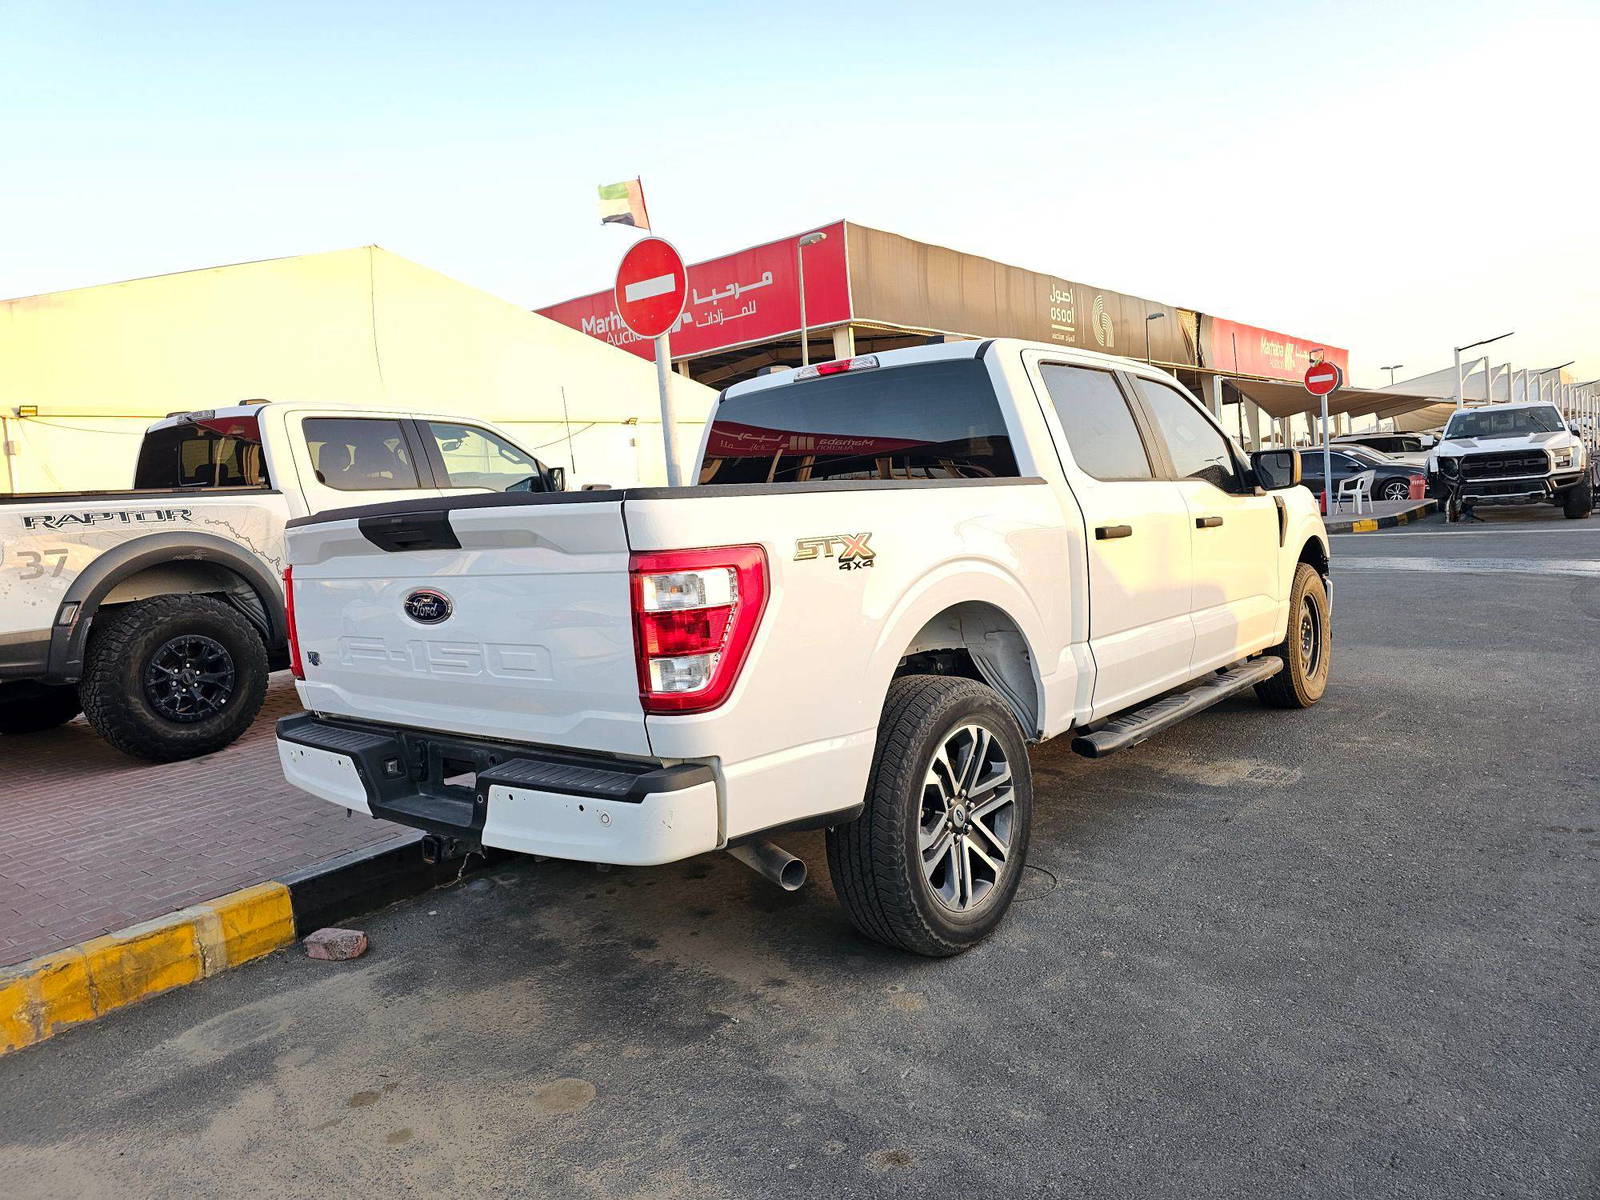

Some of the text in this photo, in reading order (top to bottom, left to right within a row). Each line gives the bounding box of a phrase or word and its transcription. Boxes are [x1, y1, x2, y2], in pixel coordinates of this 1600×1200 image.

[693, 272, 773, 305] مرحبا
[581, 311, 626, 335] Marh
[696, 300, 757, 328] للمزادات
[22, 508, 192, 532] RAPTOR
[793, 532, 877, 562] STX
[17, 548, 69, 580] 37
[412, 596, 438, 617] Ford
[337, 635, 553, 681] F-150
